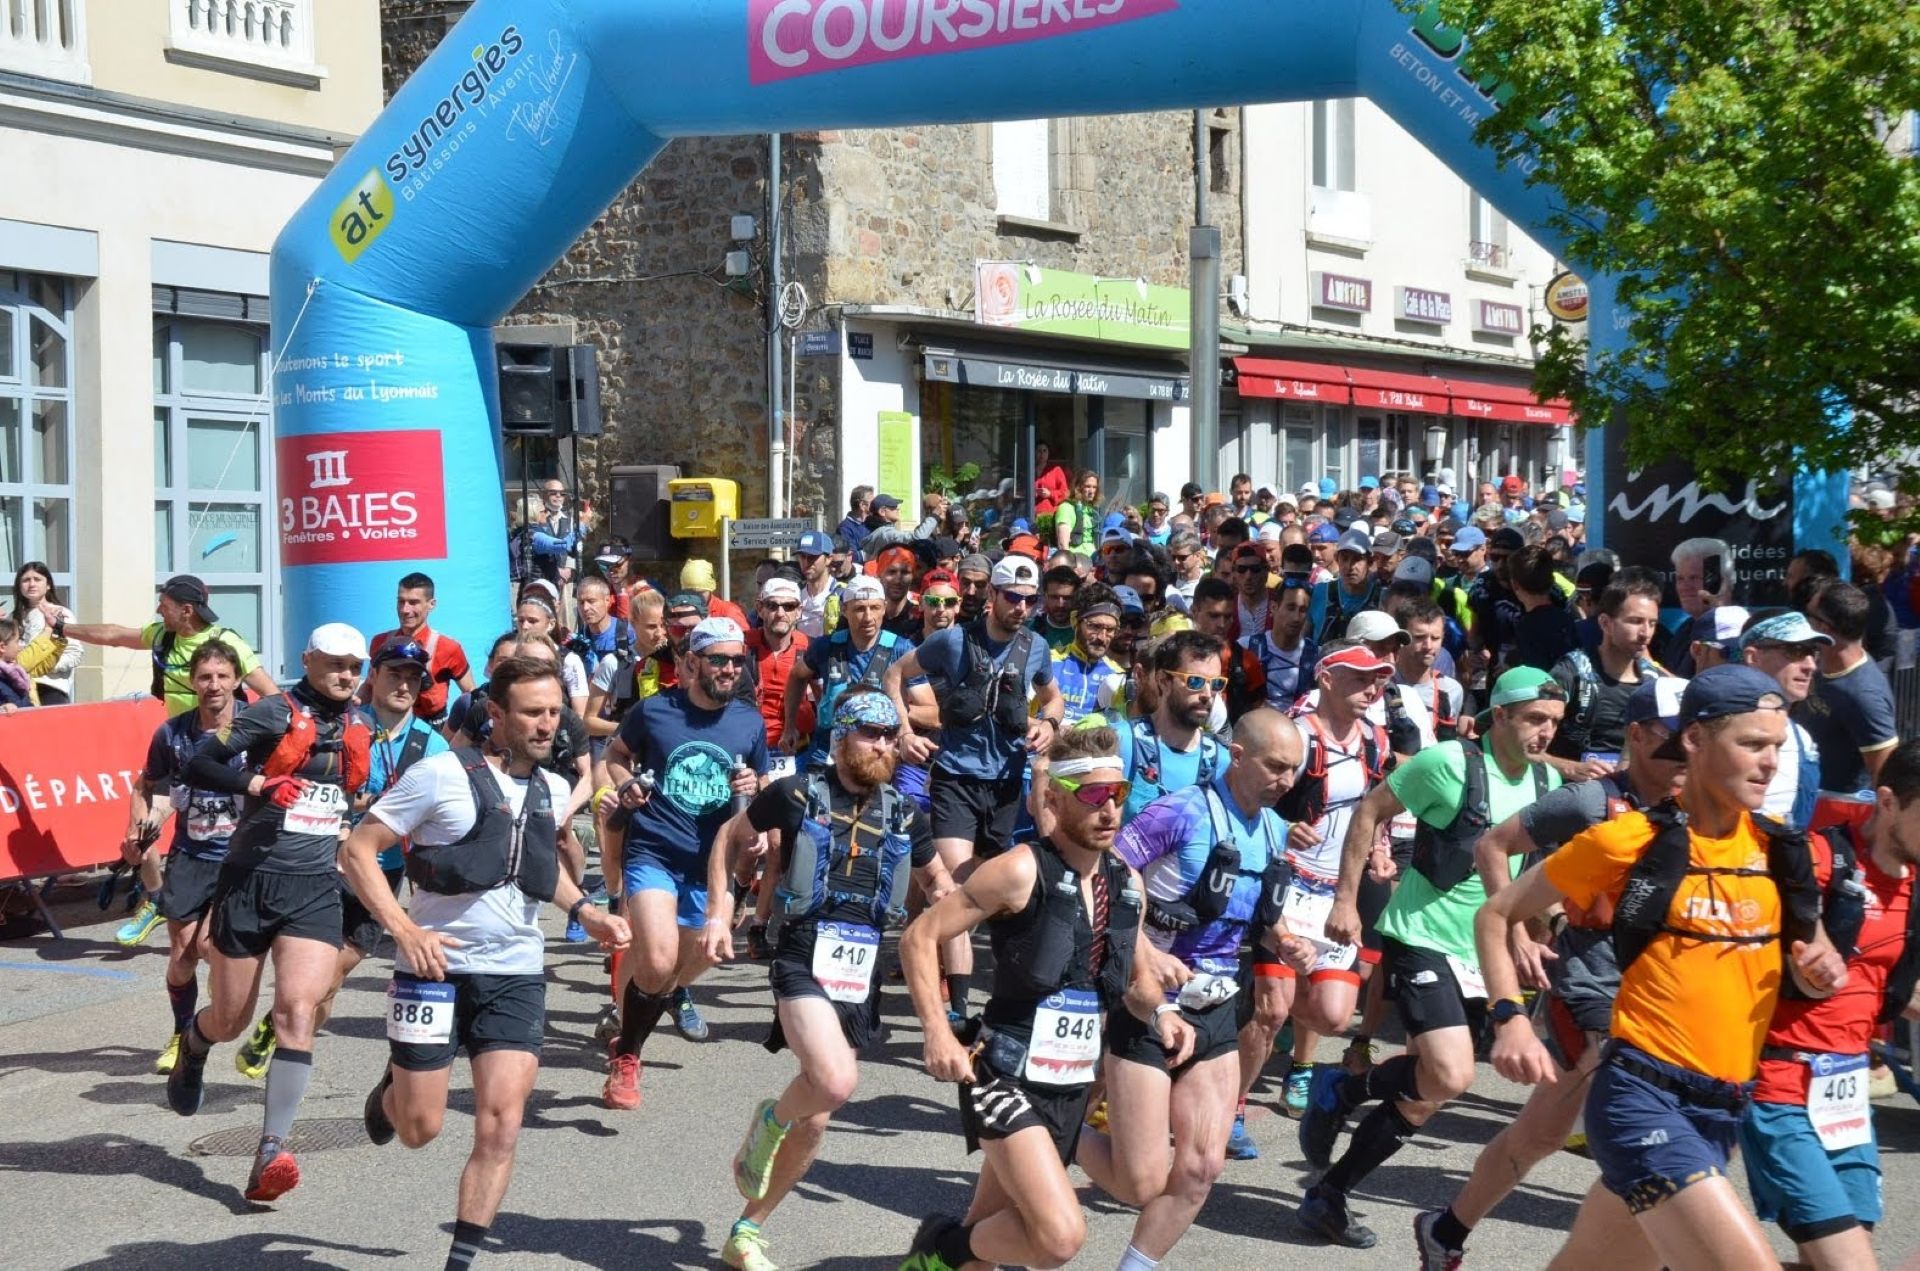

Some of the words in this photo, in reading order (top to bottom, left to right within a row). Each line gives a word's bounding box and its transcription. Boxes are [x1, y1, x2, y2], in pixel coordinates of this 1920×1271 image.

[386, 25, 524, 183] synergies
[1440, 87, 1464, 108] ET
[1025, 292, 1047, 320] La
[1051, 293, 1095, 320] Rosée
[1099, 294, 1122, 321] du
[1125, 299, 1172, 328] Matin
[334, 352, 349, 368] le
[357, 349, 405, 372] sport
[997, 365, 1015, 384] La
[1017, 368, 1050, 388] Rosée
[1053, 371, 1071, 390] du
[296, 383, 335, 405] Monts
[343, 386, 365, 401] du
[371, 378, 439, 403] Lyonnais
[282, 497, 295, 532] 3
[302, 491, 418, 530] BAIES
[282, 531, 335, 545] Fenêtres
[359, 527, 418, 541] Volets
[743, 537, 767, 546] Service
[1730, 544, 1787, 560] idées
[0, 769, 142, 814] DÉPART
[831, 944, 866, 966] 410
[393, 1002, 434, 1026] 888
[1055, 1015, 1095, 1041] 848
[1823, 1075, 1857, 1101] 403
